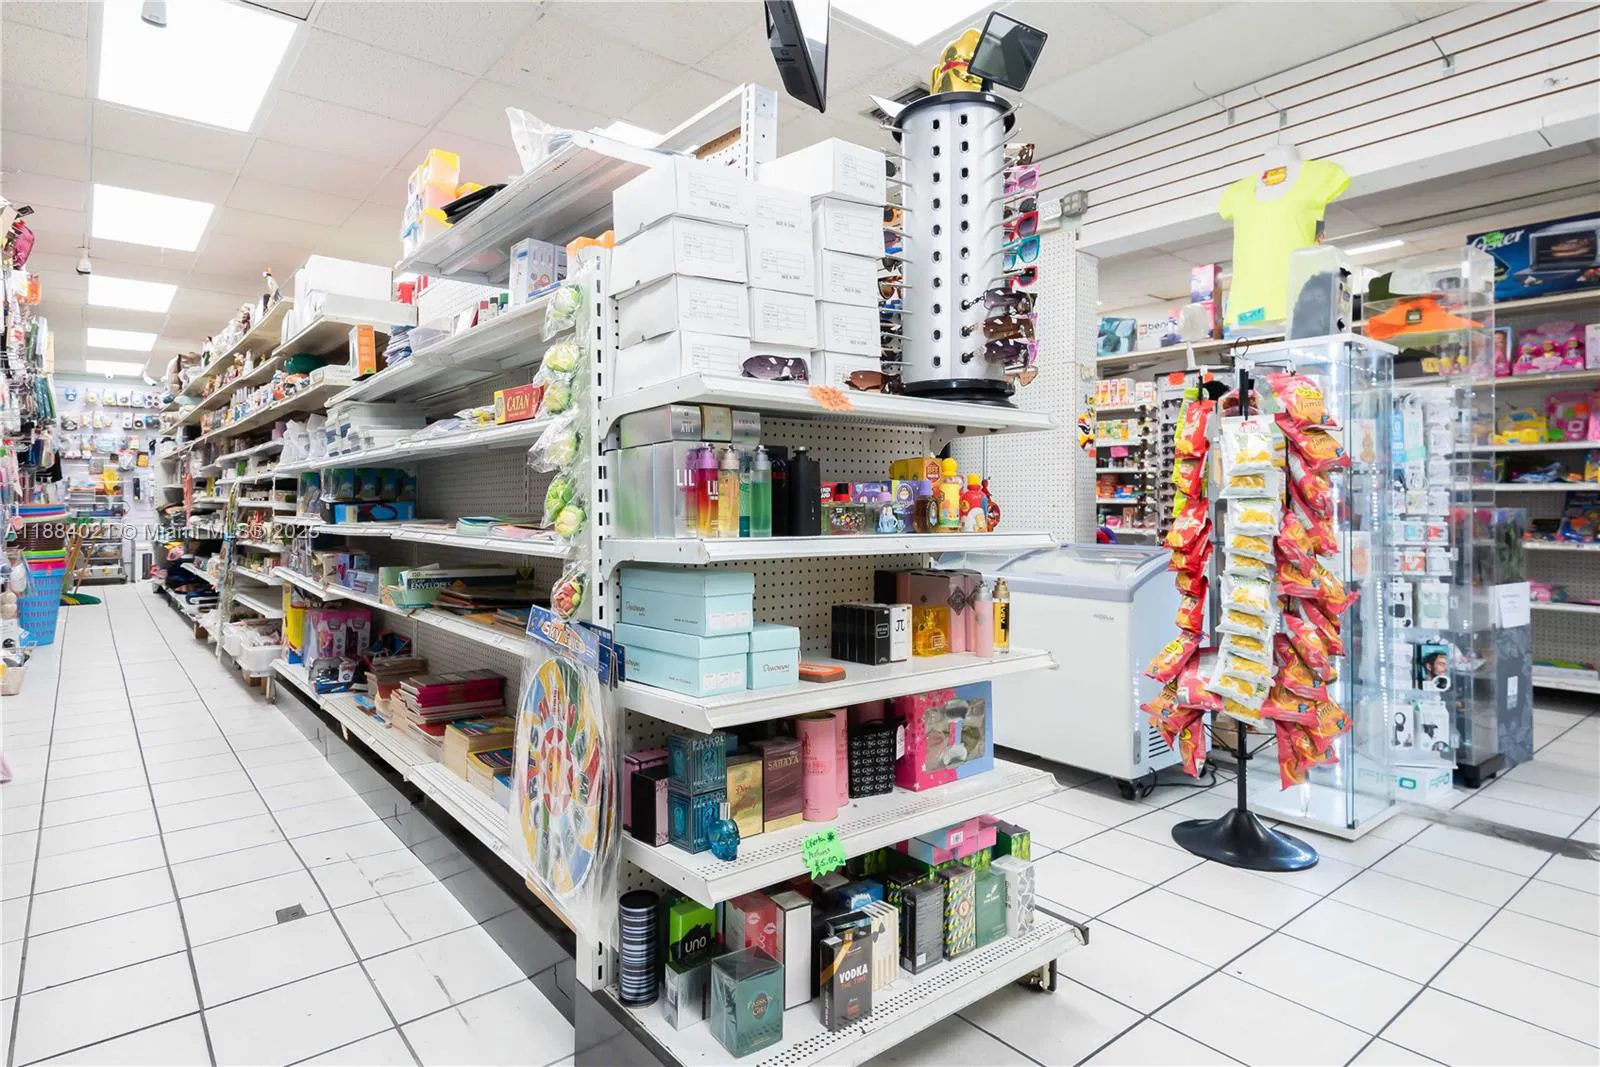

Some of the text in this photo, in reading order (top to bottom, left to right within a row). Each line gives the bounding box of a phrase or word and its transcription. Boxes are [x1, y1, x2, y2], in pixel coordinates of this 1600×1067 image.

[1471, 229, 1525, 252] Oer
[507, 394, 530, 412] CATAN
[676, 468, 695, 487] LIL
[839, 963, 868, 984] VODKA
